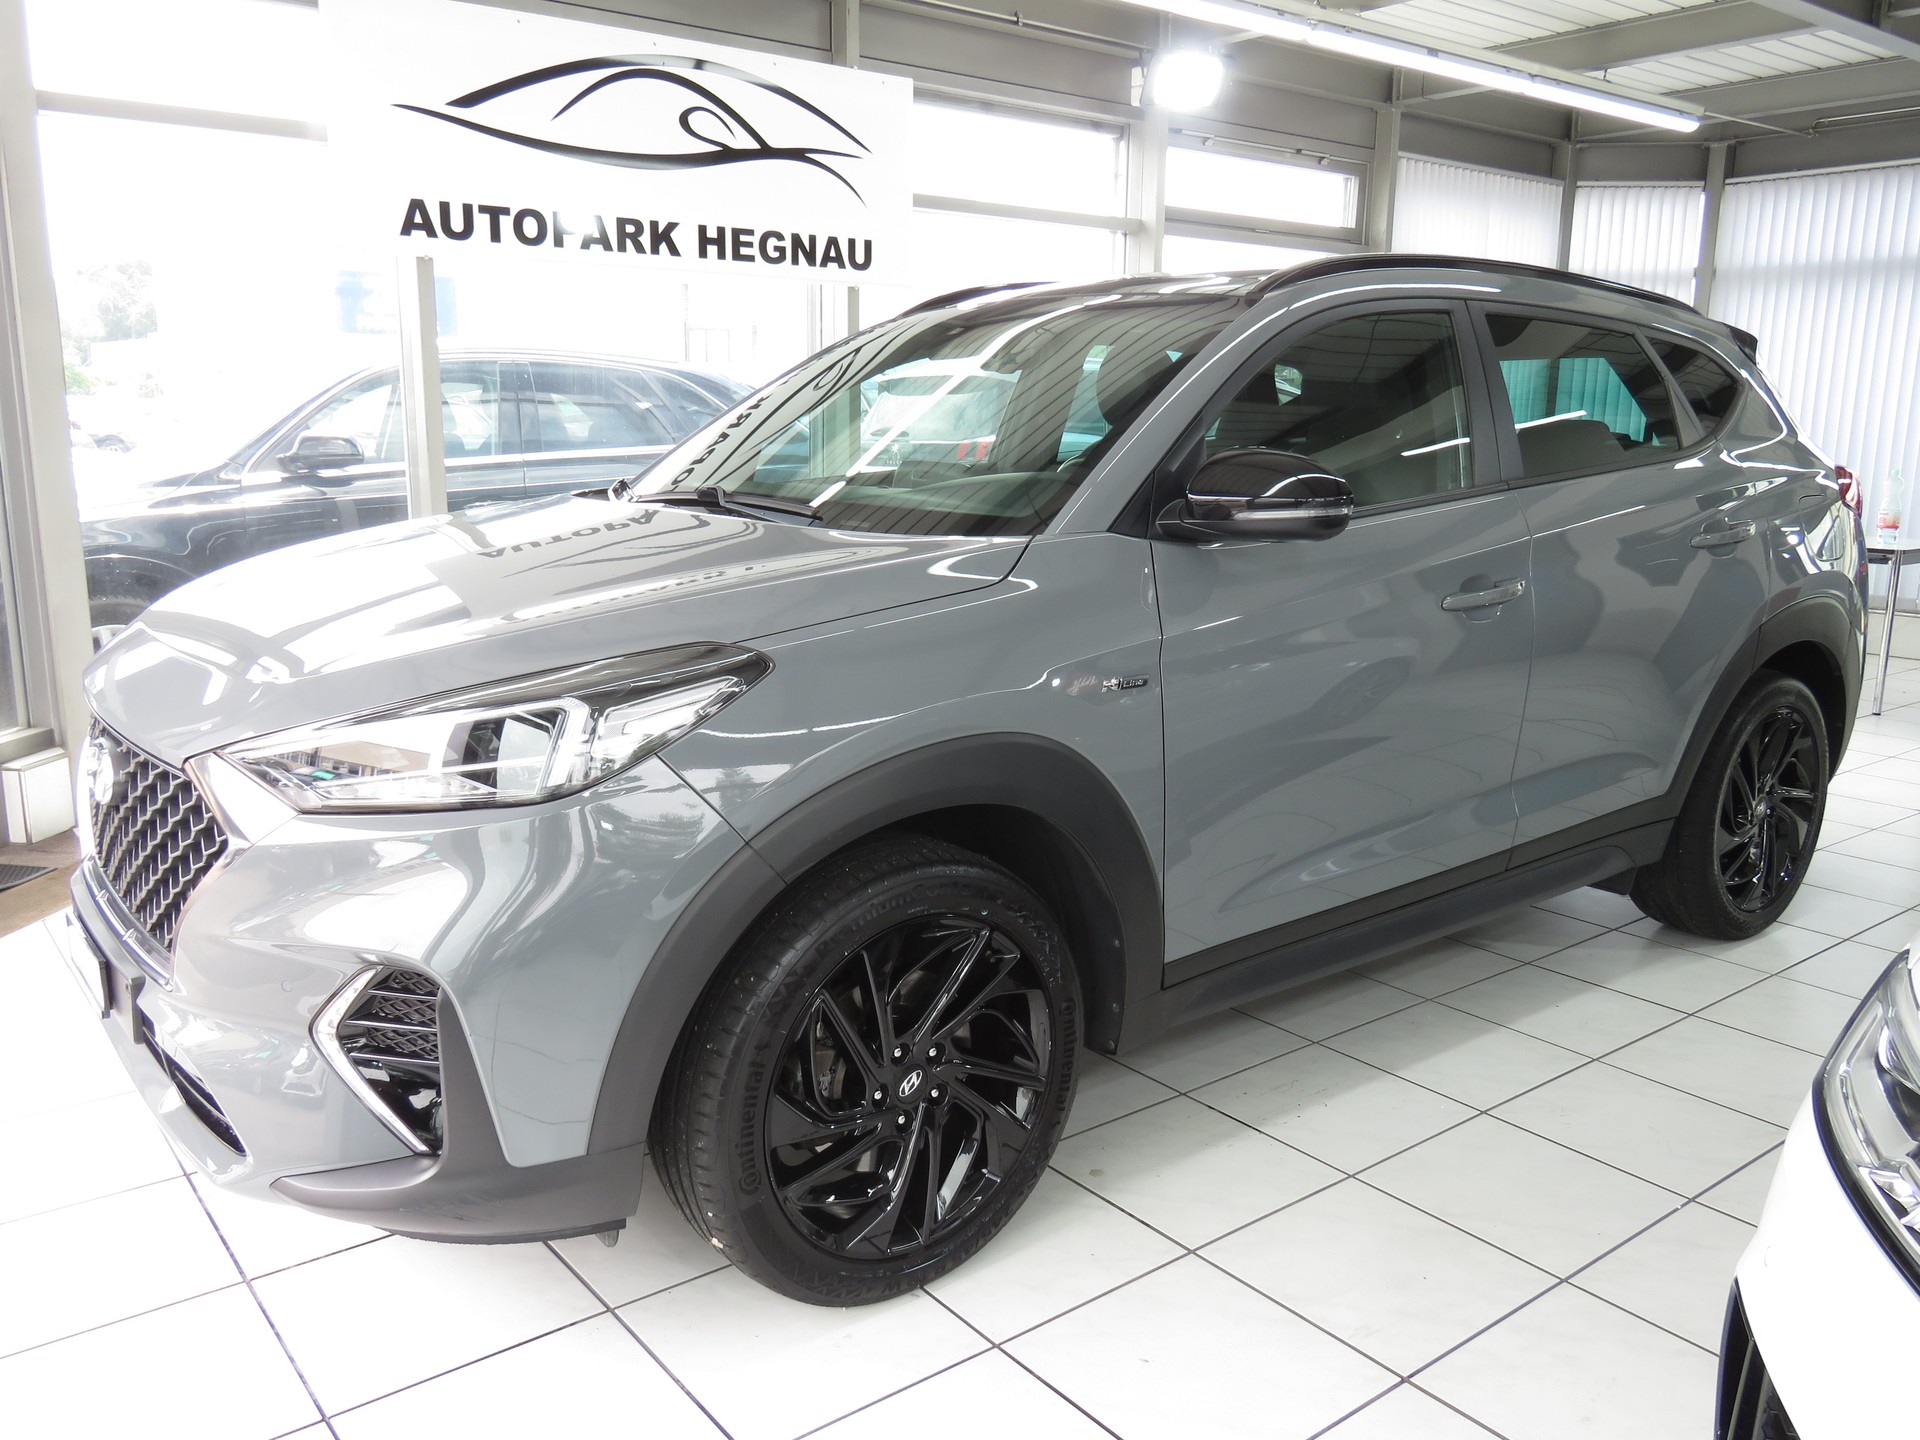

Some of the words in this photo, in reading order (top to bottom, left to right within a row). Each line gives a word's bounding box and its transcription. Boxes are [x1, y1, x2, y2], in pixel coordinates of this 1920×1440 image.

[698, 223, 873, 271] HEGNAU
[1056, 997, 1078, 1113] Continental
[734, 1059, 767, 1197] Continental
